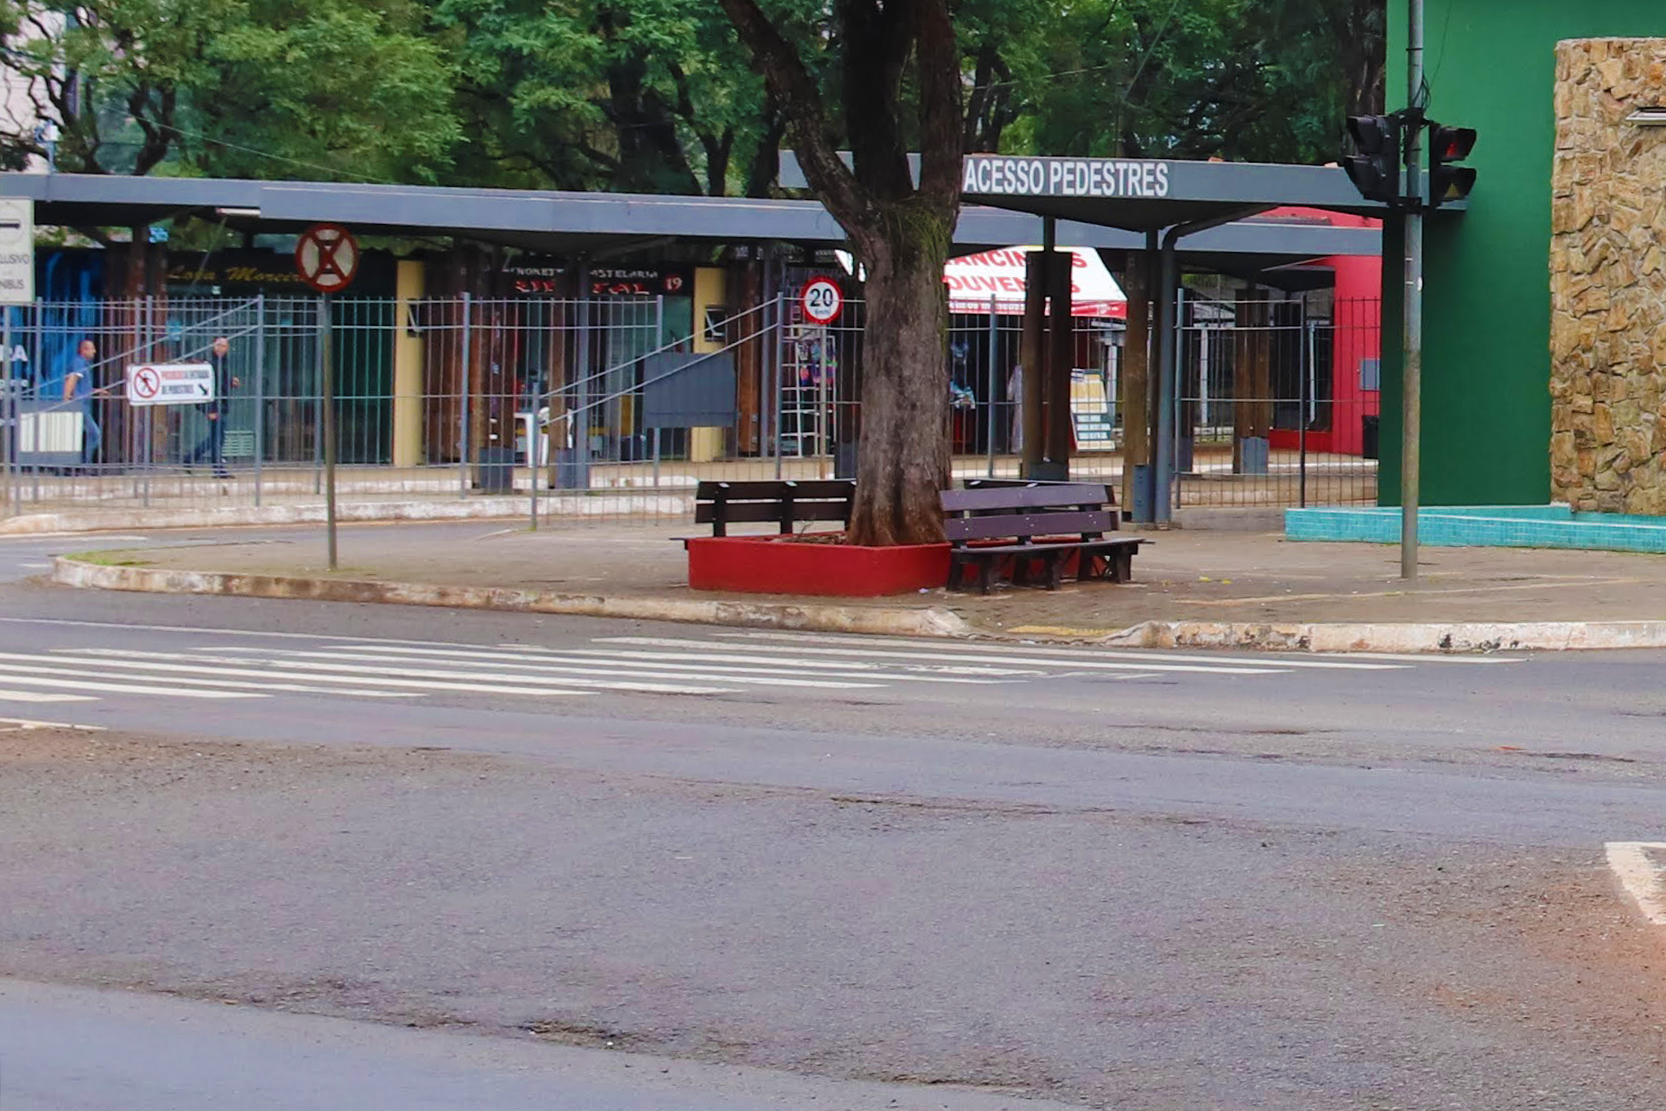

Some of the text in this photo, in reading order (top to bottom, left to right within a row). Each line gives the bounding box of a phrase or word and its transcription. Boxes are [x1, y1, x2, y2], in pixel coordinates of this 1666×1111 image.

[963, 158, 1169, 197] ACESSO PEDESTRES
[809, 288, 834, 308] 20
